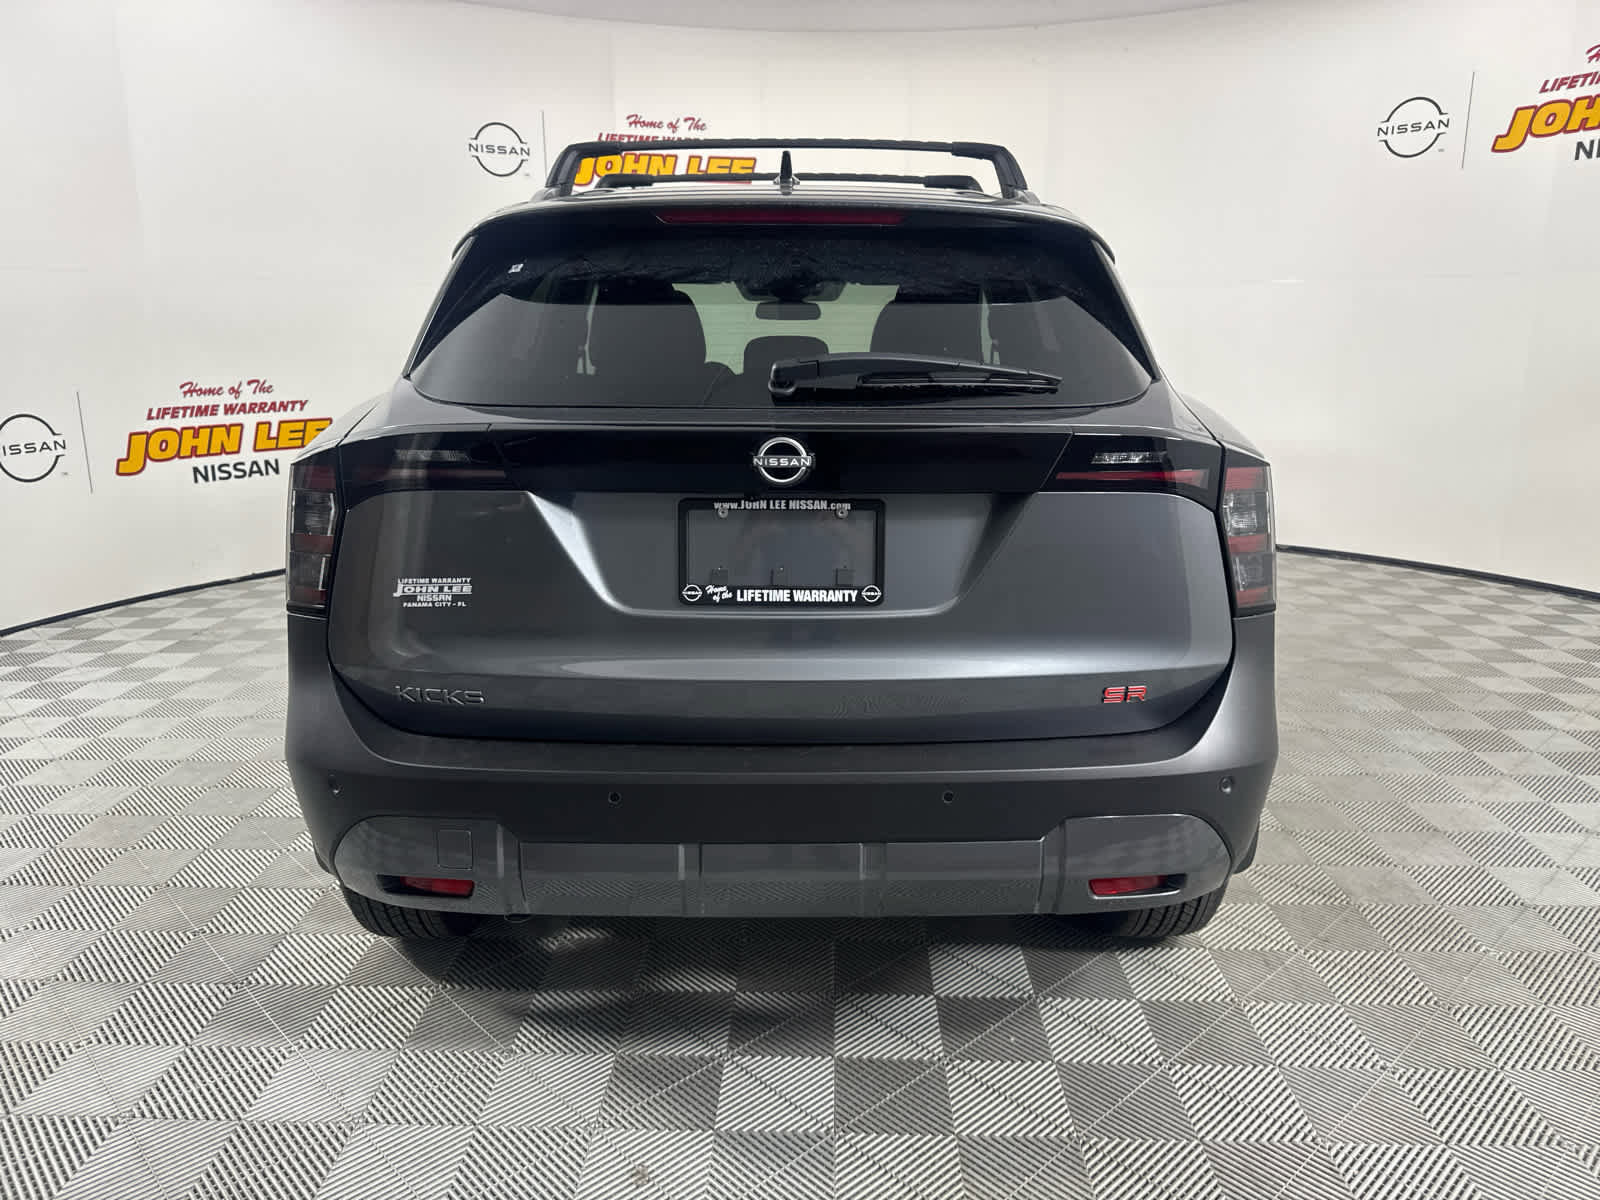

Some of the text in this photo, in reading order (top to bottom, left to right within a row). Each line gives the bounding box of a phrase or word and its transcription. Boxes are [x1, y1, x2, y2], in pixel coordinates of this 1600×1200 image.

[1538, 72, 1600, 94] LIFETI
[626, 113, 707, 133] Home of The
[1377, 118, 1450, 137] NISSAN
[1491, 93, 1600, 153] JOH
[468, 142, 531, 157] NISSAN
[574, 153, 678, 185] JOHN
[179, 379, 274, 400] Home of The
[146, 400, 309, 421] LIFETIME WARRANTY
[3, 440, 67, 457] ISSAN
[116, 423, 244, 477] JOHN
[192, 458, 280, 483] NISSAN
[753, 455, 812, 467] NISSAN
[769, 500, 787, 510] LEE
[393, 583, 473, 597] JOHN LEE
[416, 594, 452, 602] NISSAN
[736, 589, 858, 602] LIFETIME WARRANTY
[394, 685, 485, 705] KICKS
[1103, 685, 1147, 703] SR
